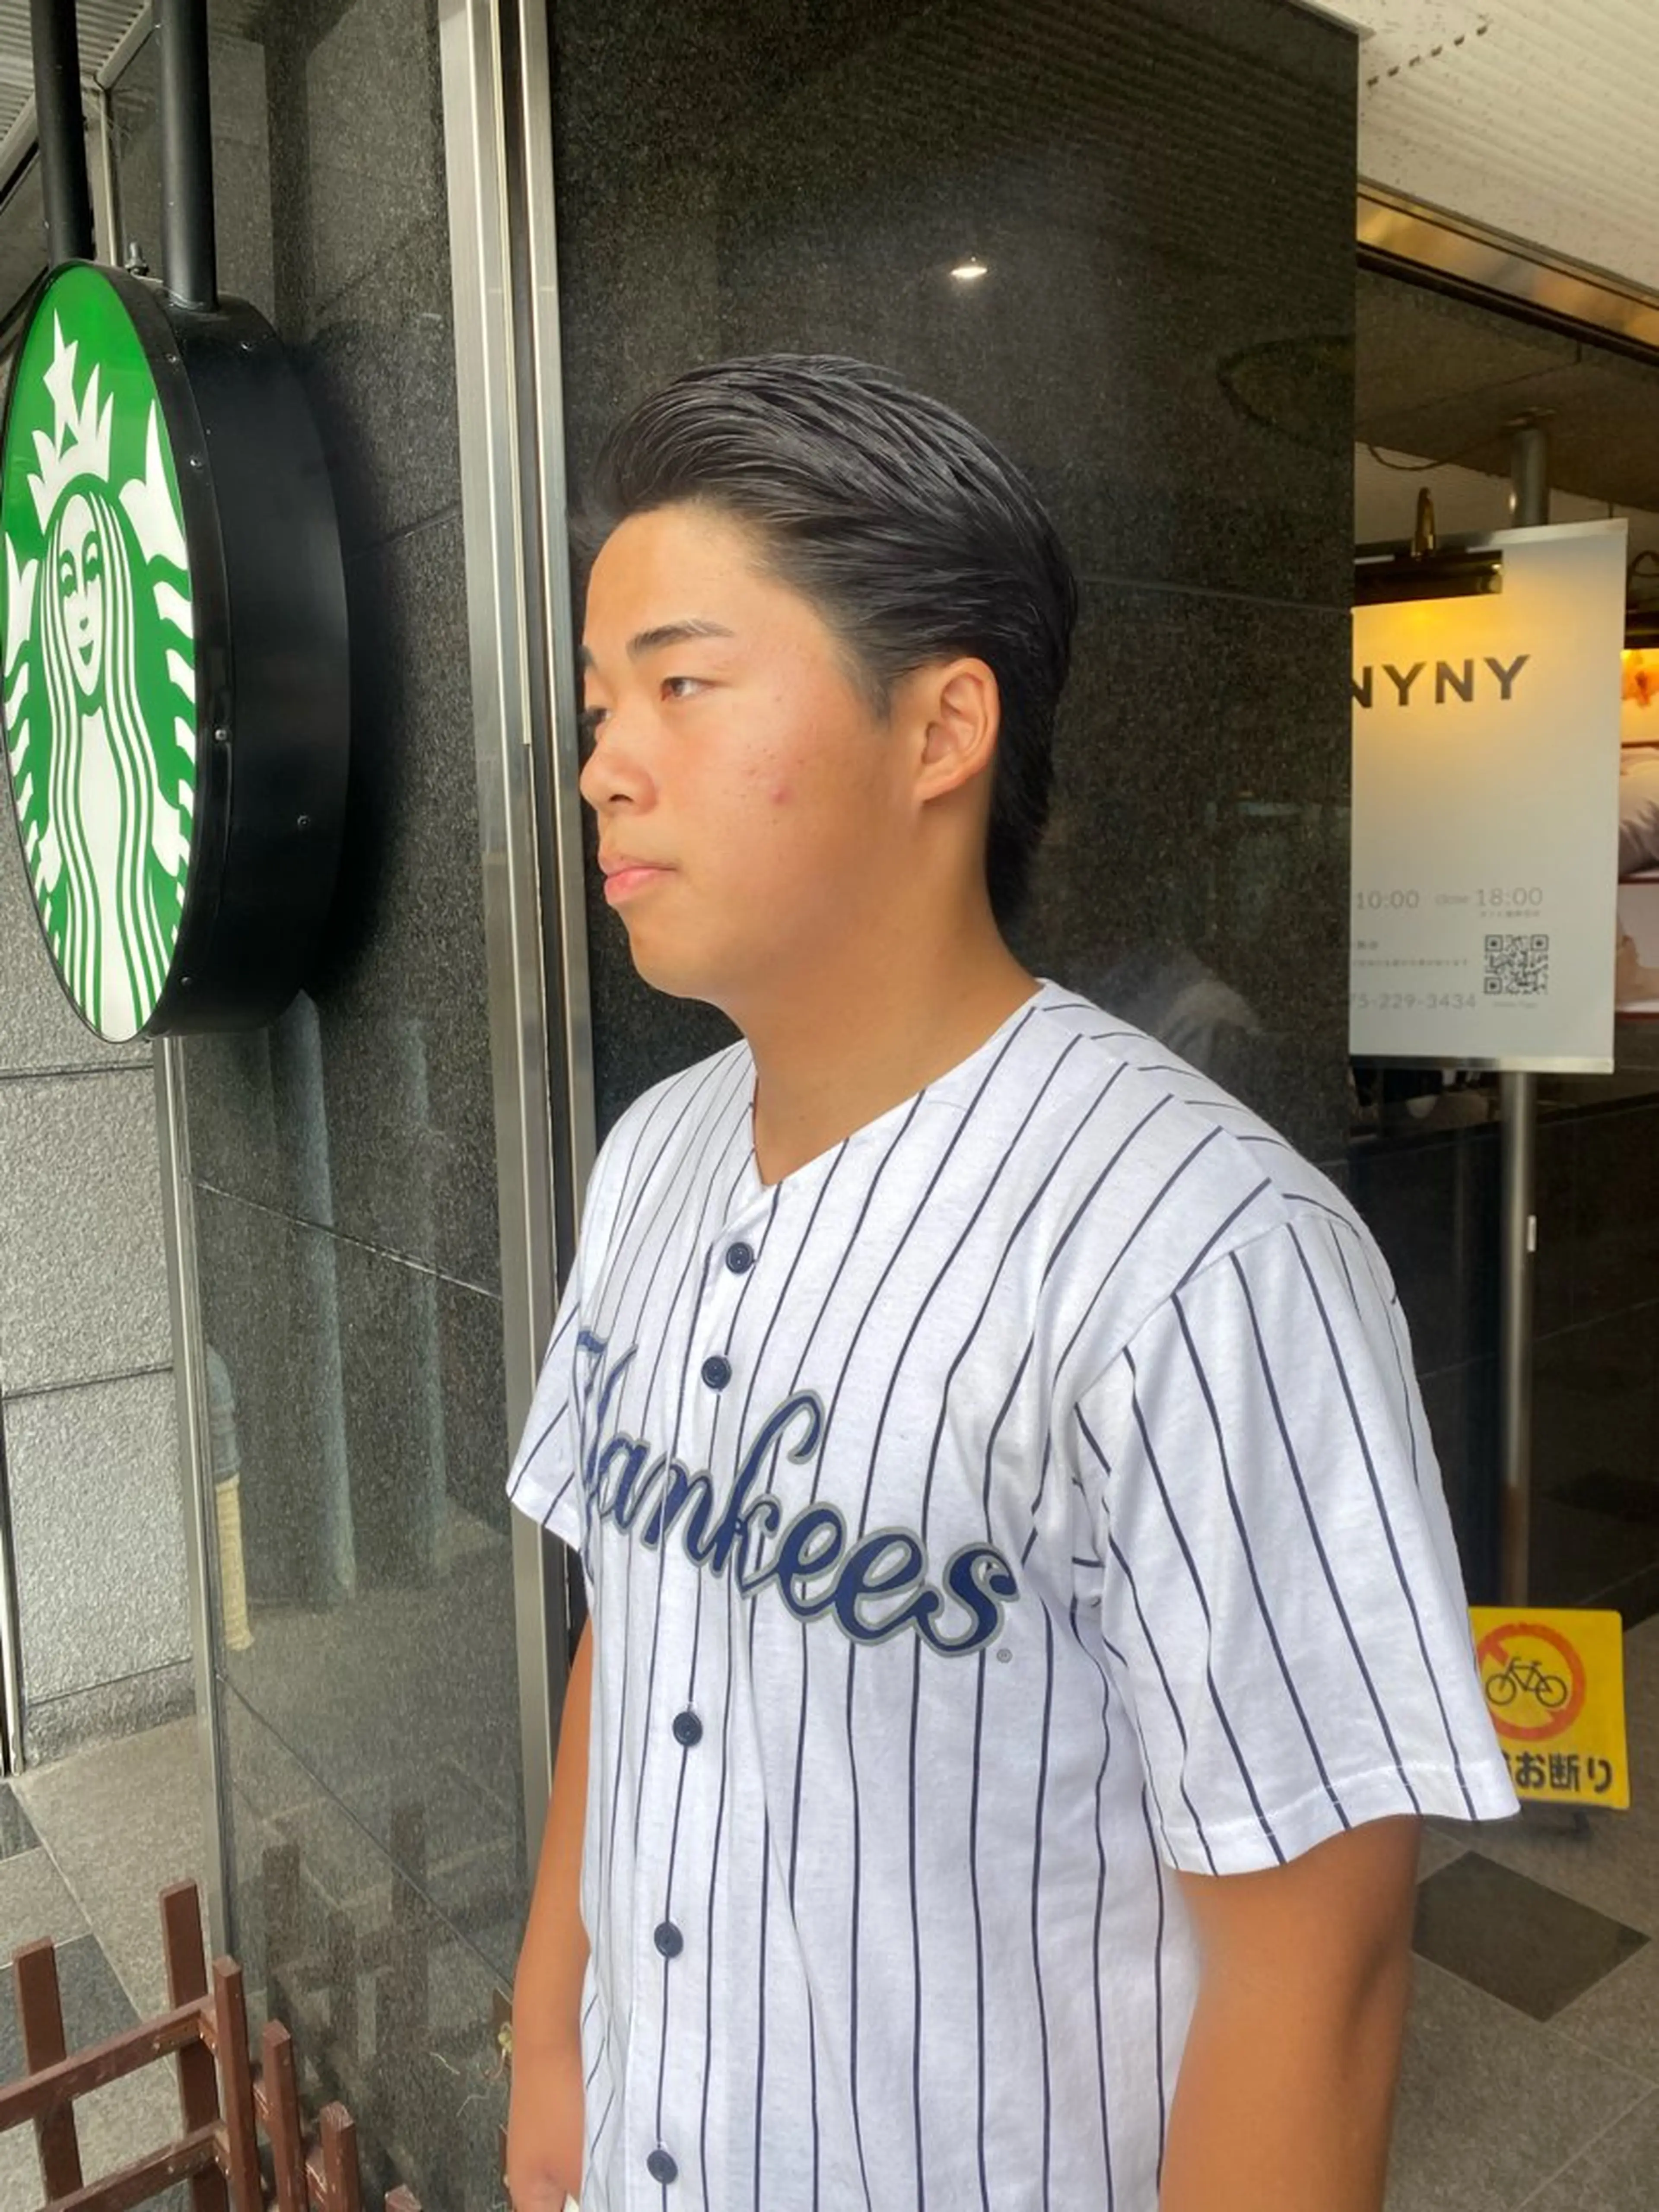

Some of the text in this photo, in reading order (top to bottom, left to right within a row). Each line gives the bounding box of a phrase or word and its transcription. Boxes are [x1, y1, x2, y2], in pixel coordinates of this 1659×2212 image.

[1357, 889, 1420, 910] 10:00
[1477, 887, 1542, 907] 18:00
[576, 1327, 1020, 1658] Yankees
[1503, 1751, 1612, 1794] お断り
